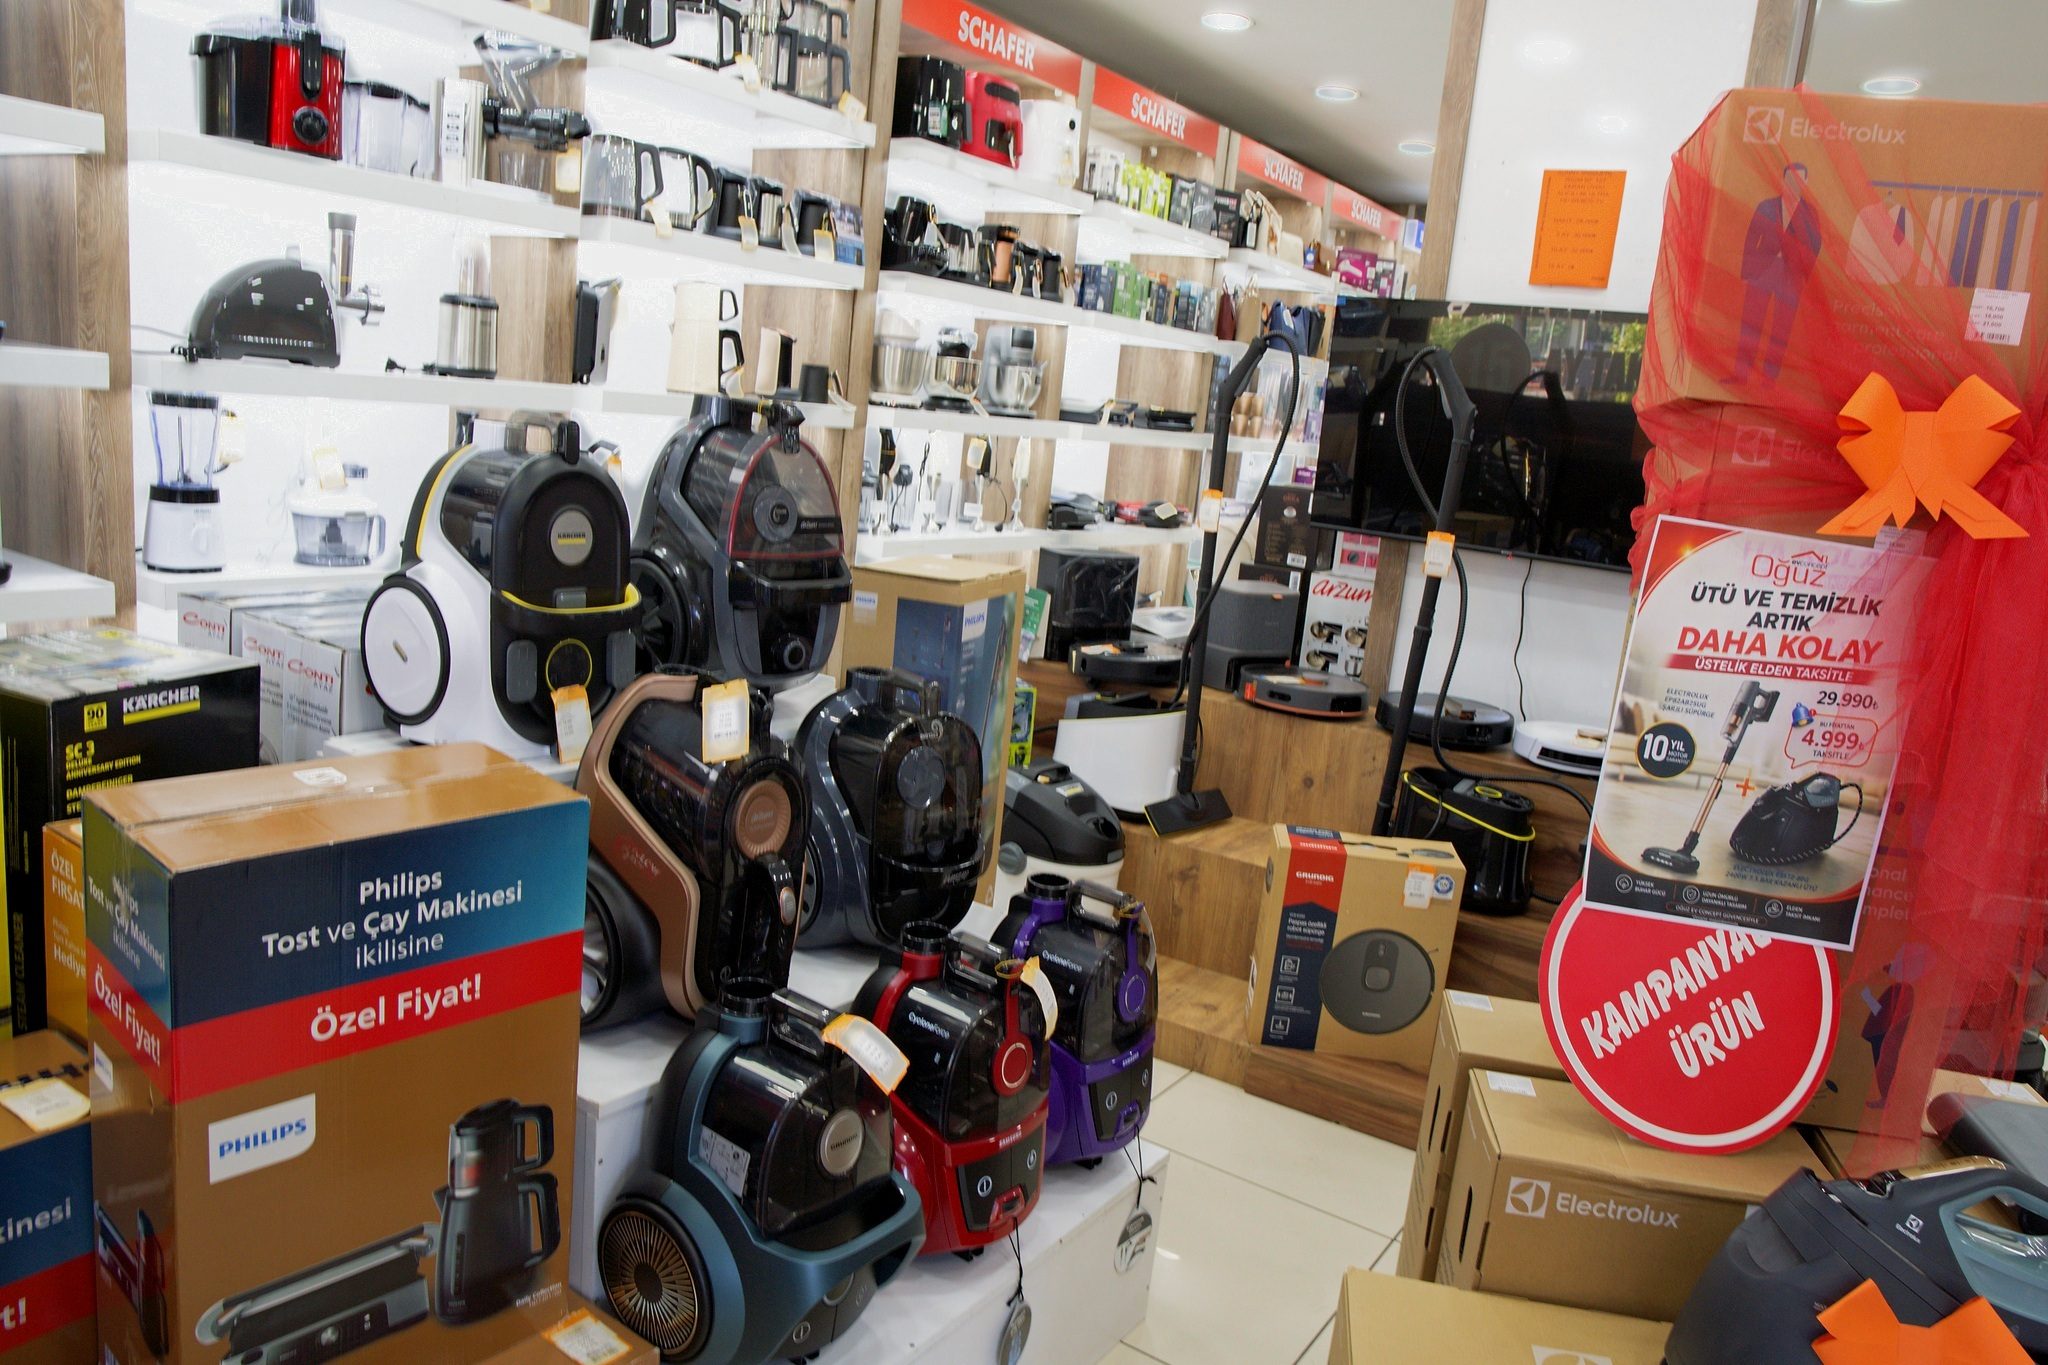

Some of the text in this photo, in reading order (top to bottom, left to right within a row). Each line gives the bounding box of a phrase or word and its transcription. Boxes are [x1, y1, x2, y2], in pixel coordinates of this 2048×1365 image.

[958, 10, 1036, 71] SCHAFER
[1130, 92, 1186, 140] SCHAFER
[1789, 116, 1906, 145] Electrolux
[1264, 155, 1304, 193] SCHAFER
[1351, 199, 1382, 230] SCHAFER
[1751, 554, 1826, 588] Oğuz
[1691, 581, 1884, 617] ÜTÜ VE TEMİZLİK
[1747, 612, 1814, 632] ARTIK
[1677, 626, 1884, 665] DAHA KOLAY
[1694, 655, 1854, 682] ÜSTELİK ELDEN TAKSİTLE
[122, 685, 200, 714] KÄRCHER
[65, 740, 95, 761] SC 3
[115, 753, 141, 770] EDITION
[1643, 733, 1669, 761] 10
[1671, 739, 1686, 752] YIL
[67, 801, 81, 815] STE
[51, 847, 77, 884] ÖZEL
[1870, 865, 1907, 883] onal
[359, 871, 442, 905] Philips
[88, 876, 104, 905] Tost
[105, 896, 114, 914] ve
[130, 919, 165, 972] Makinesi
[262, 880, 522, 958] Tost ve Çay Makinesi
[356, 932, 444, 970] ikilisine
[94, 963, 122, 1022] Özel
[125, 1000, 160, 1061] Fiyat!
[310, 973, 482, 1042] Özel Fiyat!
[1580, 928, 1772, 1060] KAMPANYA
[1668, 990, 1766, 1078] ÜRÜN
[218, 1116, 308, 1160] PHILIPS
[1554, 1191, 1680, 1230] Electrolux
